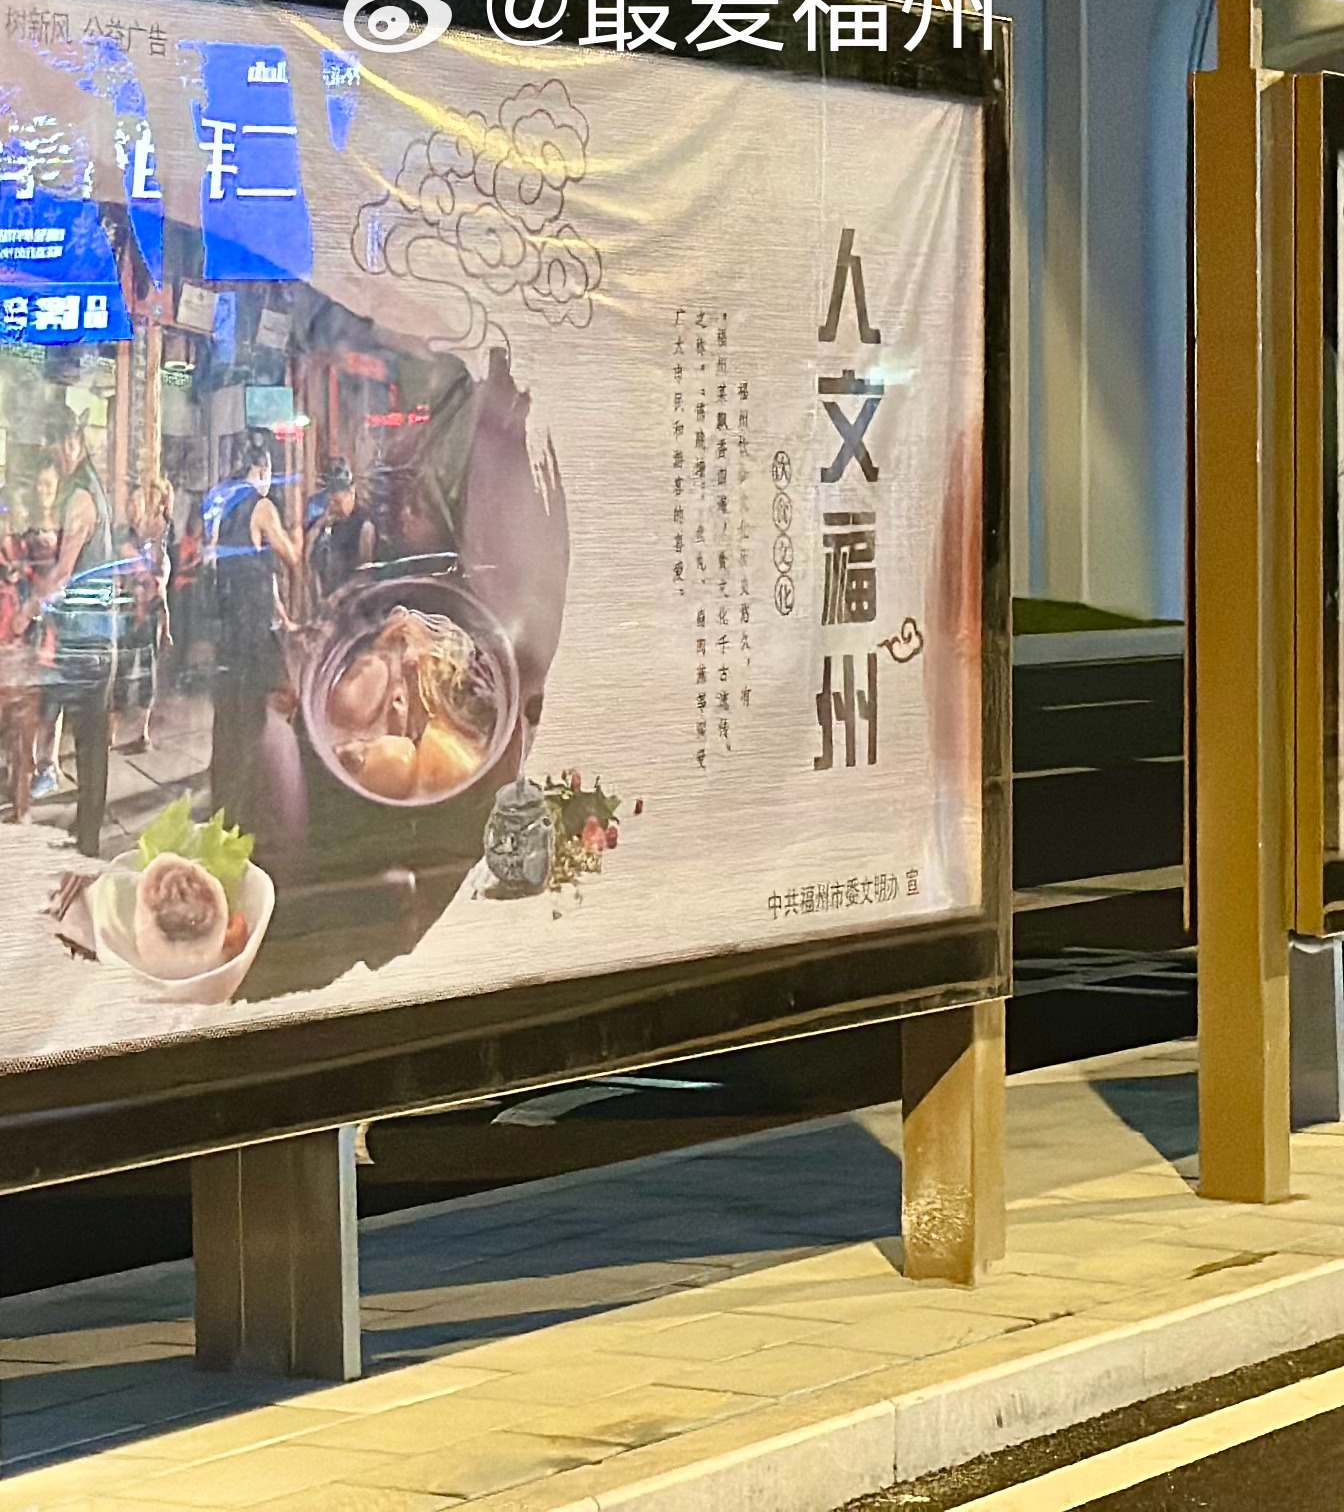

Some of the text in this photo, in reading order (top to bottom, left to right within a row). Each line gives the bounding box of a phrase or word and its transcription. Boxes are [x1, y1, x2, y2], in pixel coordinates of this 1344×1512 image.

[812, 228, 886, 772] 人文福州
[905, 868, 921, 897] 宣
